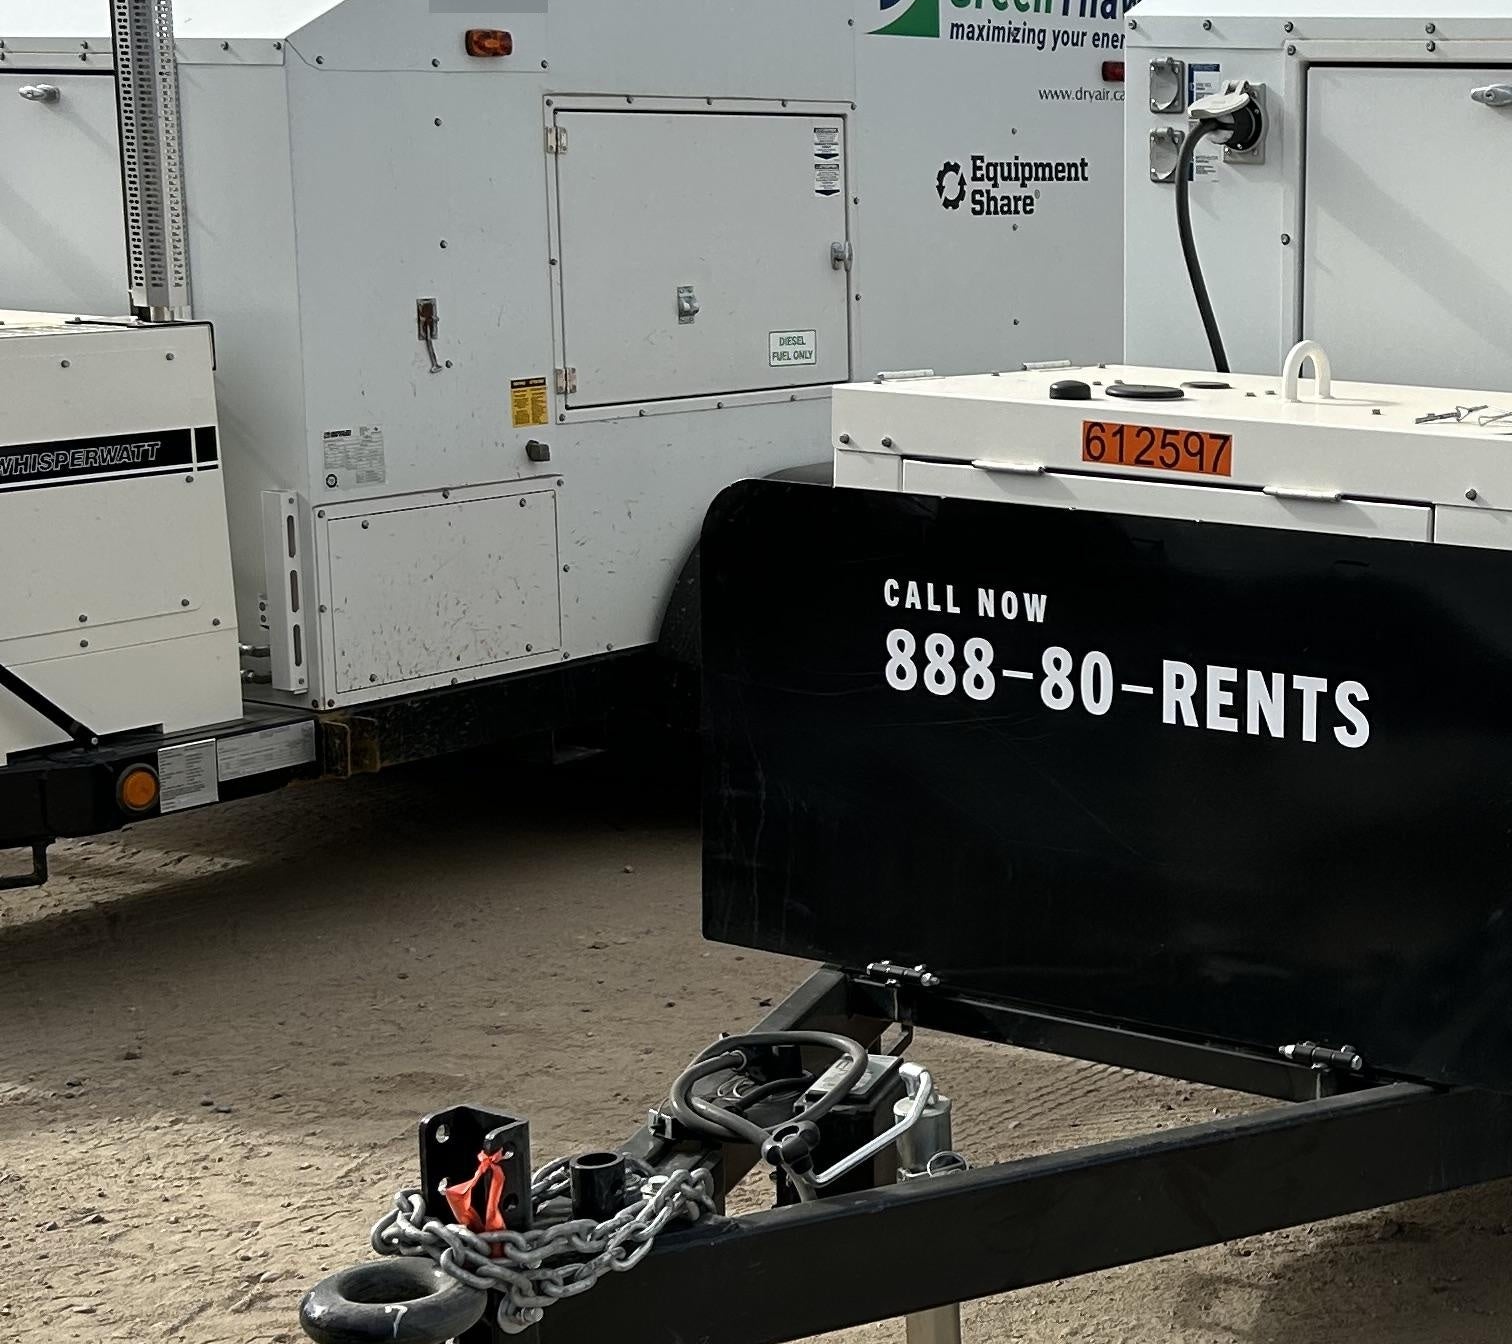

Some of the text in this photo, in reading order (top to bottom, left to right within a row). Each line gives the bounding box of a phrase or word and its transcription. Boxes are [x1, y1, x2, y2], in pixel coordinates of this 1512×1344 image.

[949, 19, 1047, 51] maximizing
[1052, 28, 1087, 51] your
[970, 155, 1089, 188] Equipment
[970, 189, 1035, 216] Share
[772, 350, 813, 361] FUEL ONLY
[779, 336, 806, 347] DIESEL
[1086, 422, 1231, 473] 612597
[884, 578, 1047, 623] CALL NOW
[884, 628, 1371, 749] 888-80-RENTS
